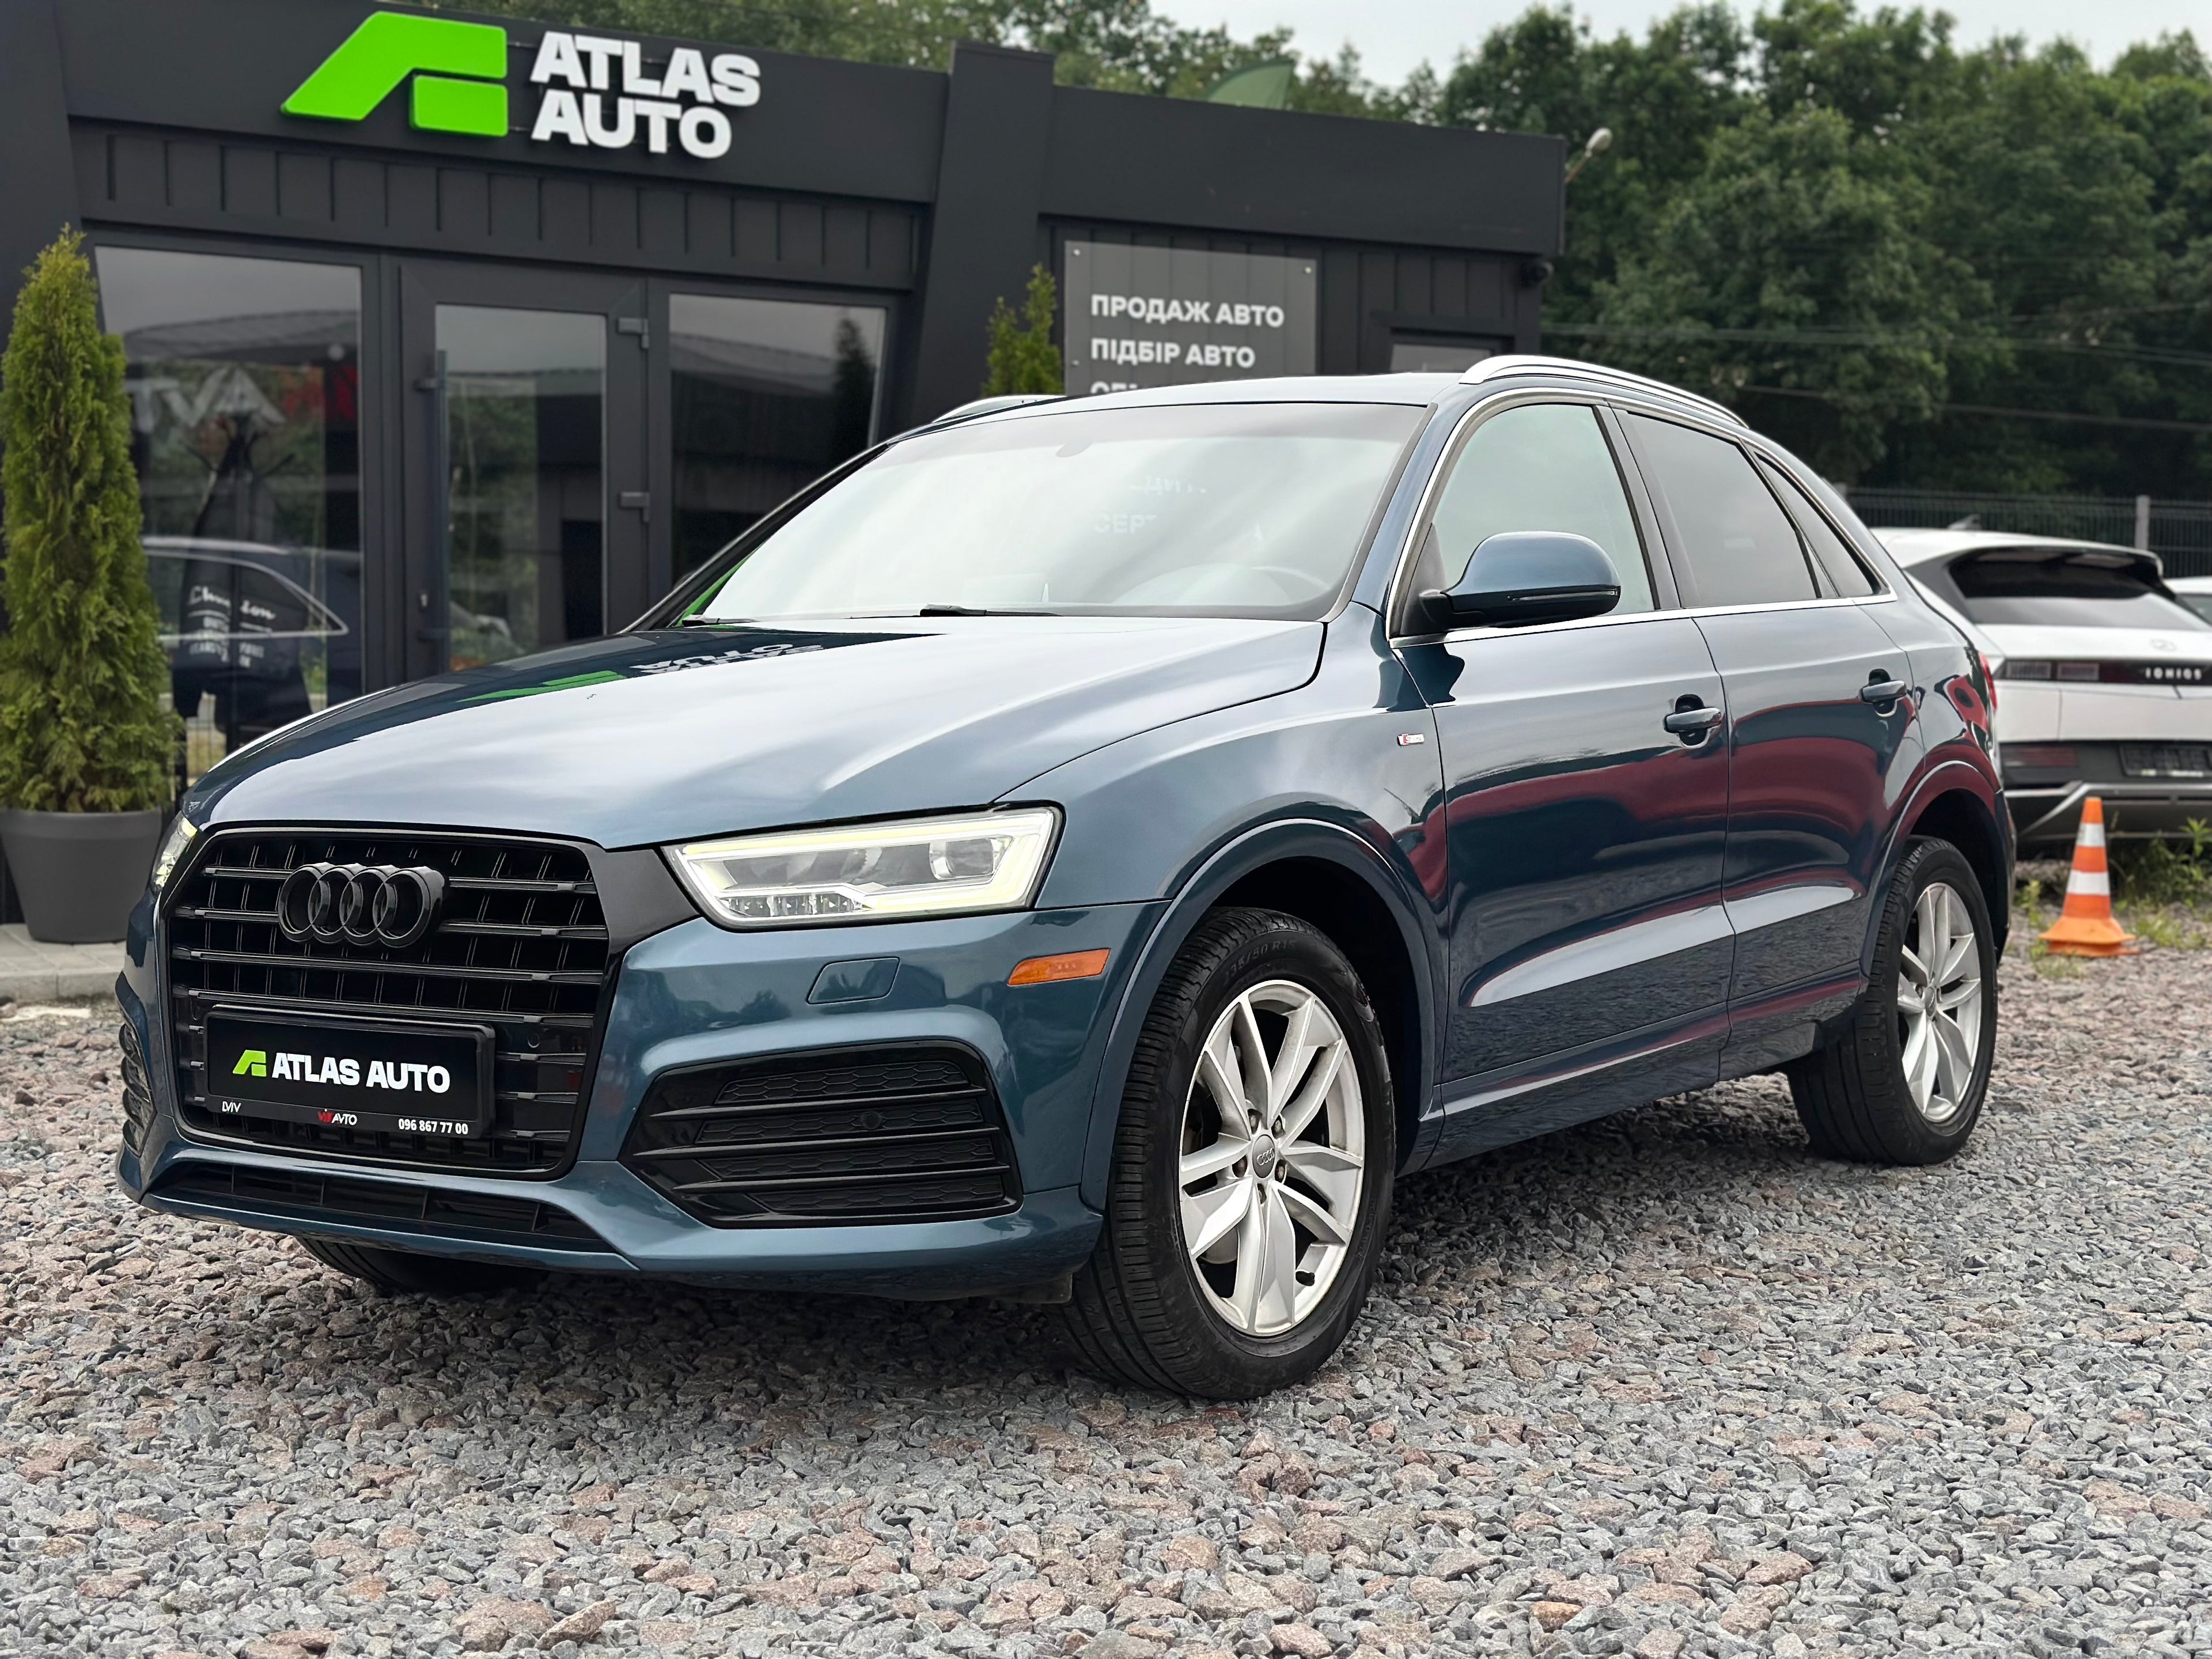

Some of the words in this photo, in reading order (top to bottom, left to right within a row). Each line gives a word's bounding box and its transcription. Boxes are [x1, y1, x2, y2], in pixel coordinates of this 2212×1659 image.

[531, 31, 761, 107] ATLAS
[531, 89, 733, 159] AUTO
[1091, 294, 1211, 325] ПРОДАЖ
[1215, 303, 1285, 328] АВТО
[1091, 338, 1181, 366] ПІДБІР
[1185, 344, 1256, 369] АВТО
[272, 1052, 361, 1086] ATLAS
[366, 1061, 451, 1094] AUTO
[399, 1119, 418, 1131] 096
[419, 1120, 438, 1133] 867
[440, 1122, 453, 1134] 77
[455, 1123, 469, 1135] 00
